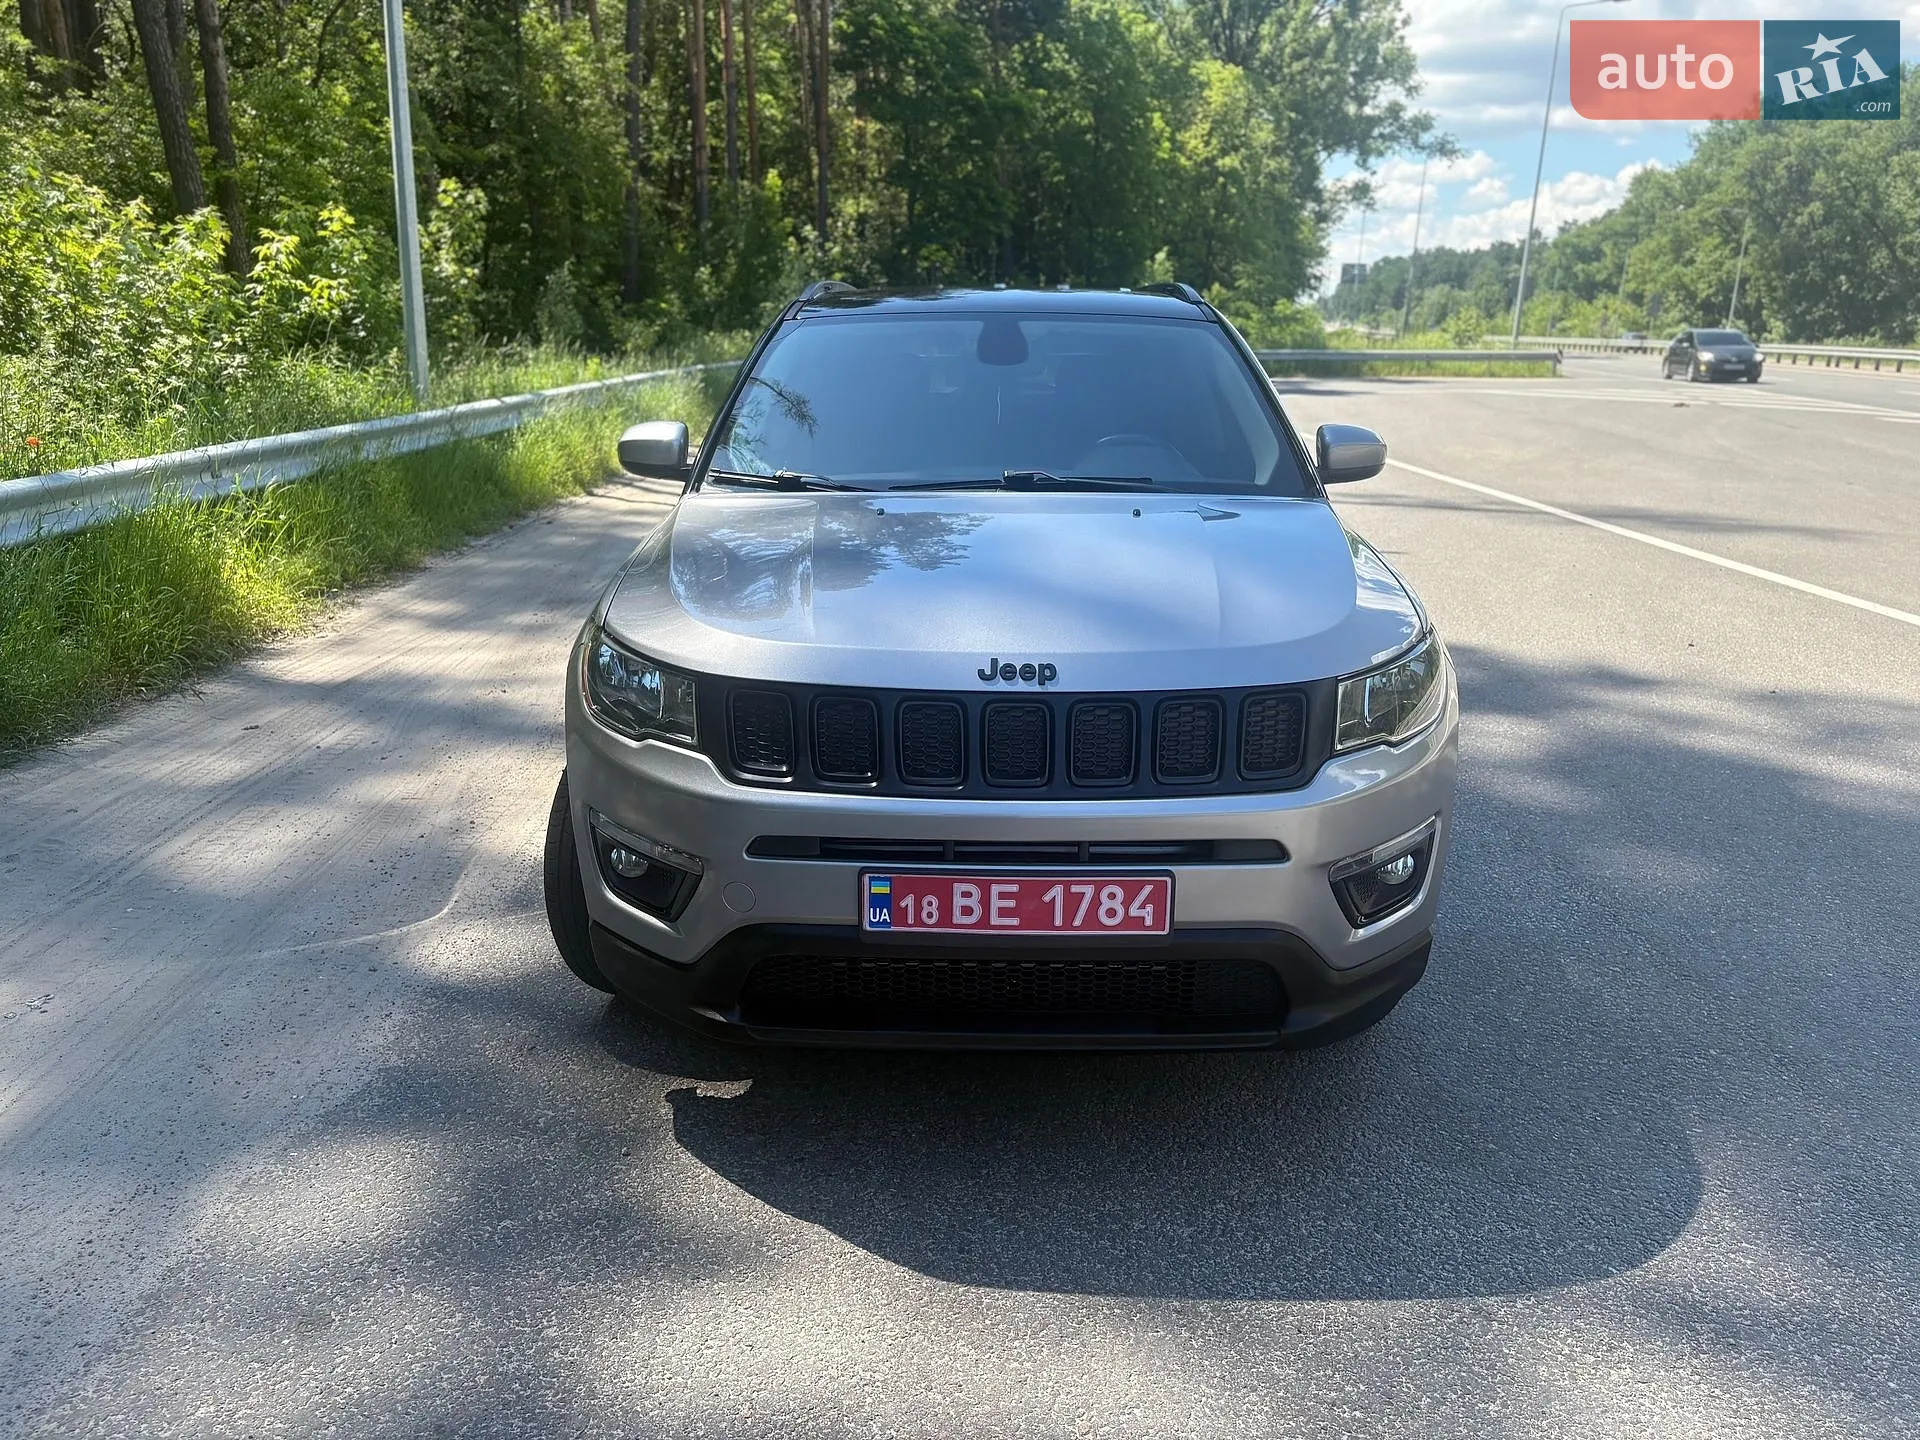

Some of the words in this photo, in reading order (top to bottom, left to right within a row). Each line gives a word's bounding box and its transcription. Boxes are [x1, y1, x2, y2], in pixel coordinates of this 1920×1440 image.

[977, 657, 1057, 686] Jeep
[869, 907, 891, 923] UA
[899, 893, 939, 925] 18
[952, 882, 1020, 926] BE
[1041, 884, 1154, 927] 1784
